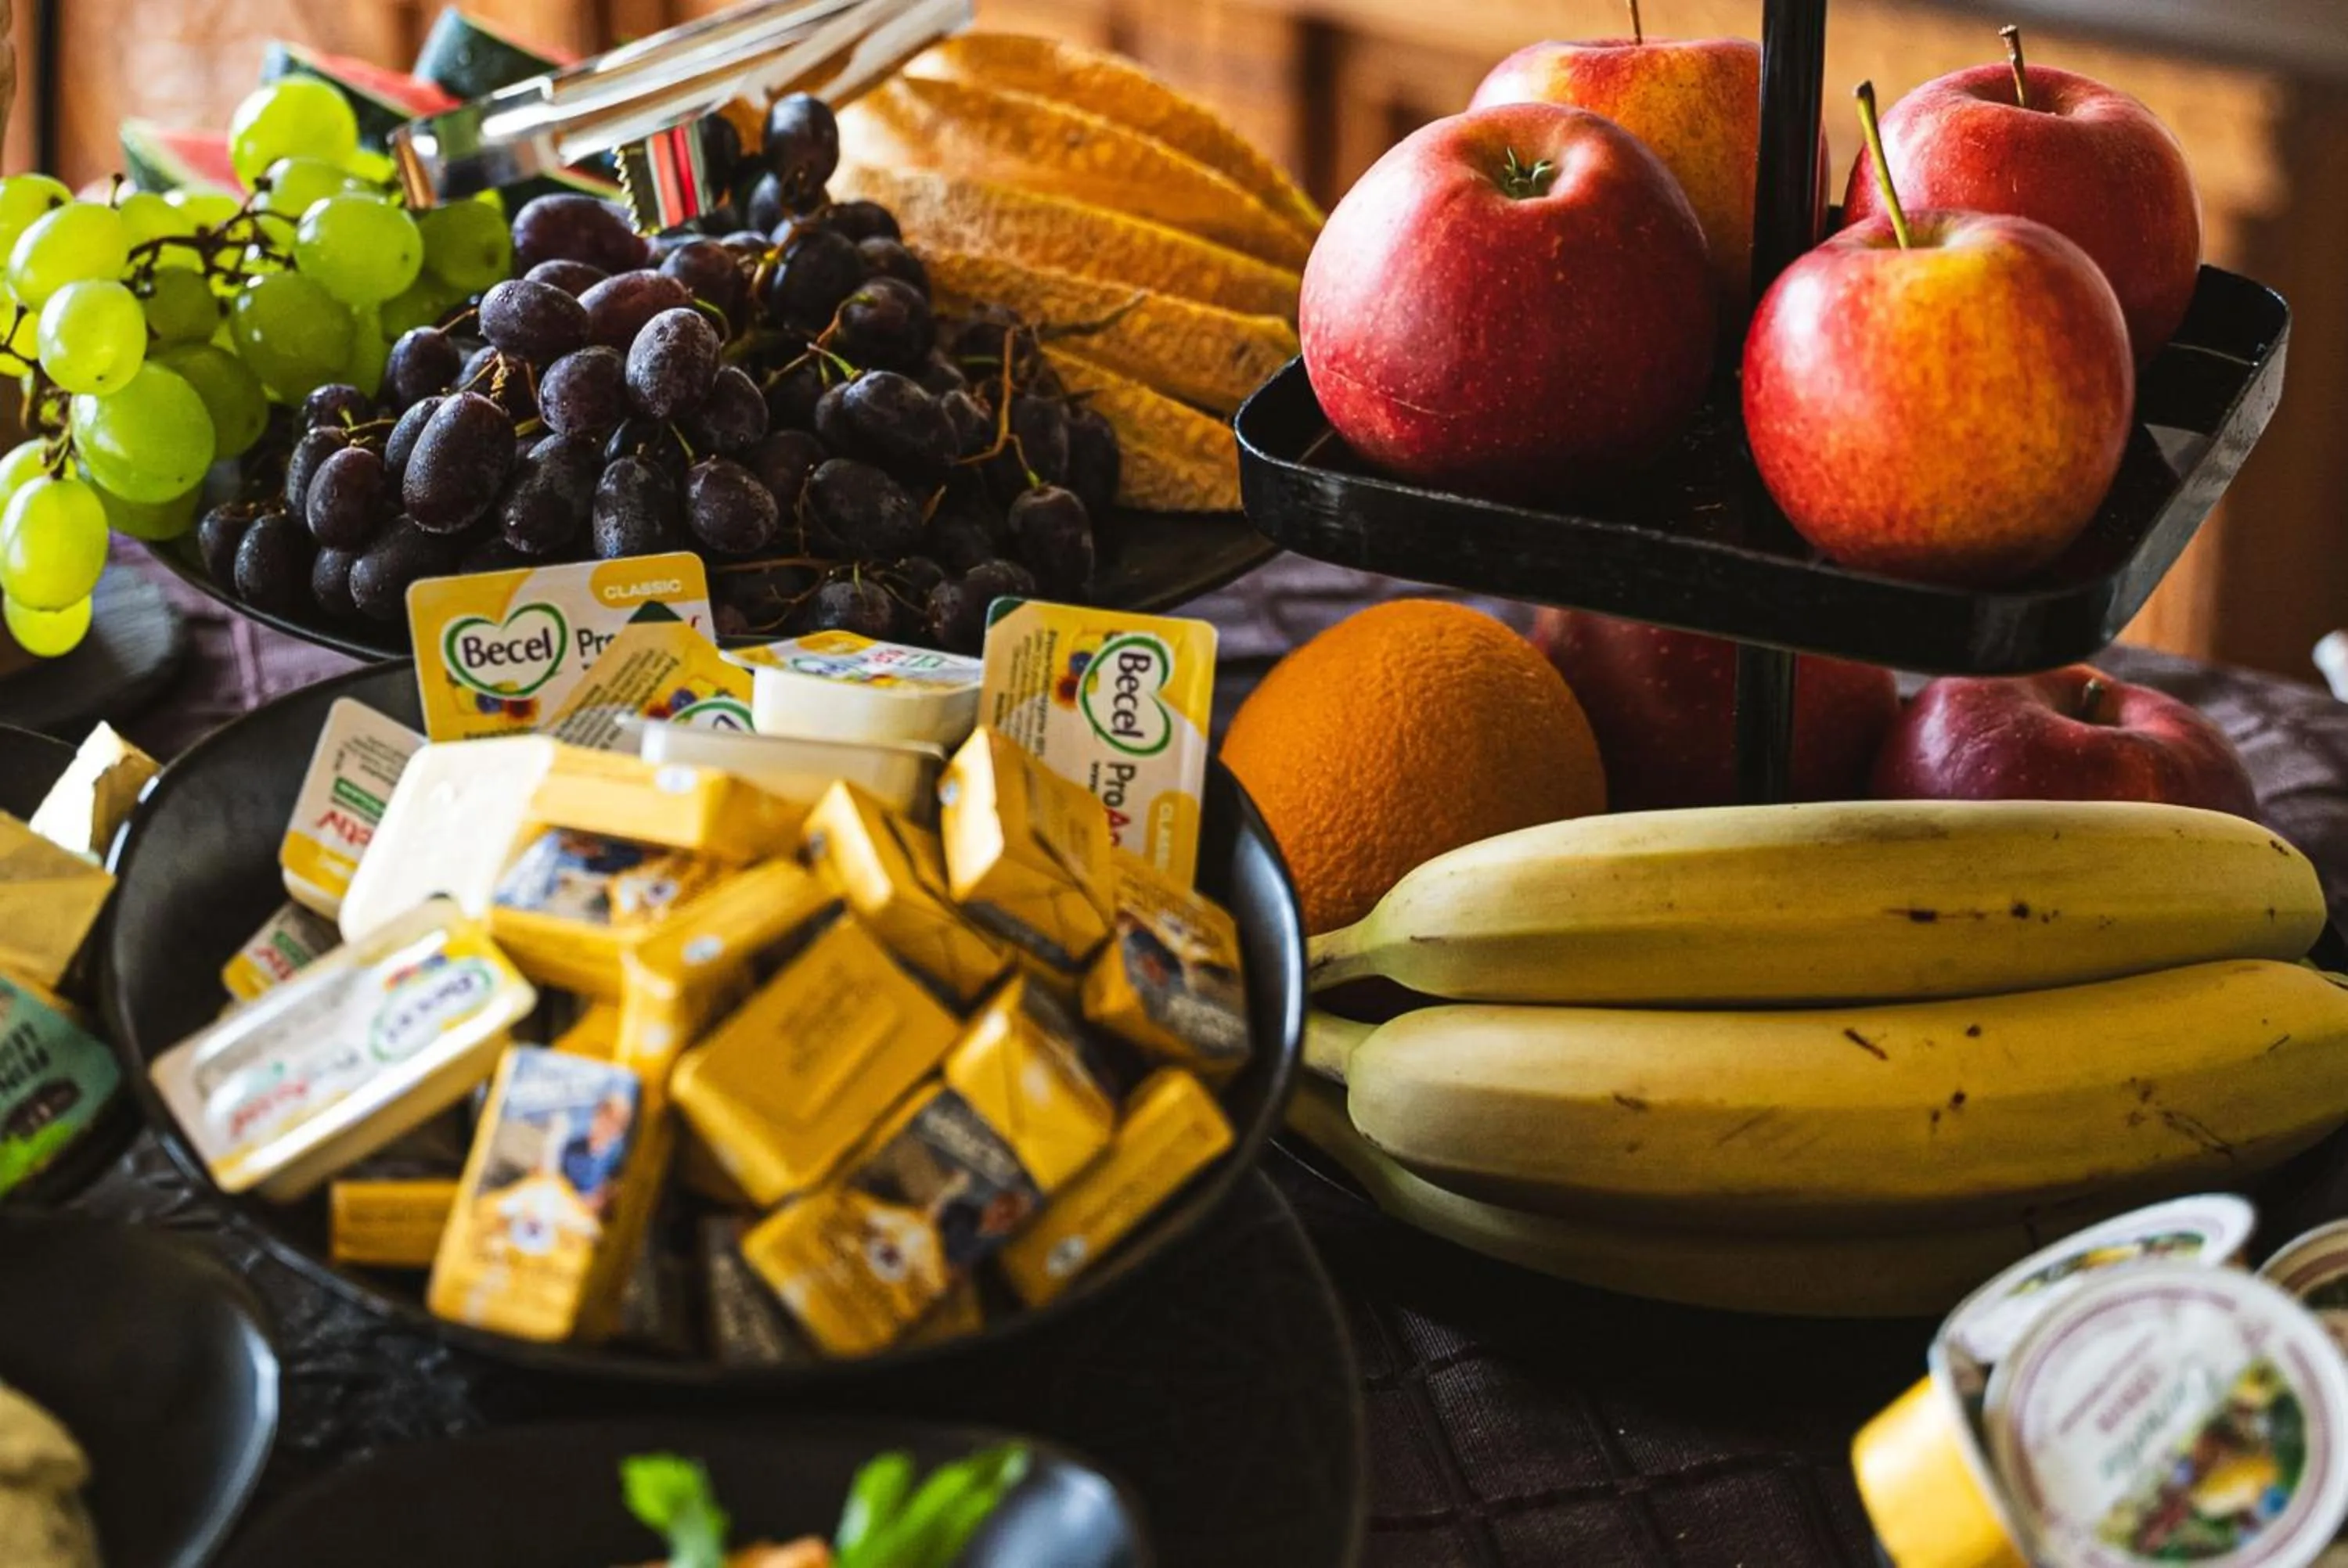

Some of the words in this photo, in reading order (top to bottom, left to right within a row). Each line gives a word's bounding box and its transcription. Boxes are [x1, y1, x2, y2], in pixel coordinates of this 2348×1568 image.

[603, 579, 682, 599] CLASSIC
[461, 628, 554, 668] Becel
[1110, 651, 1152, 739] Becel
